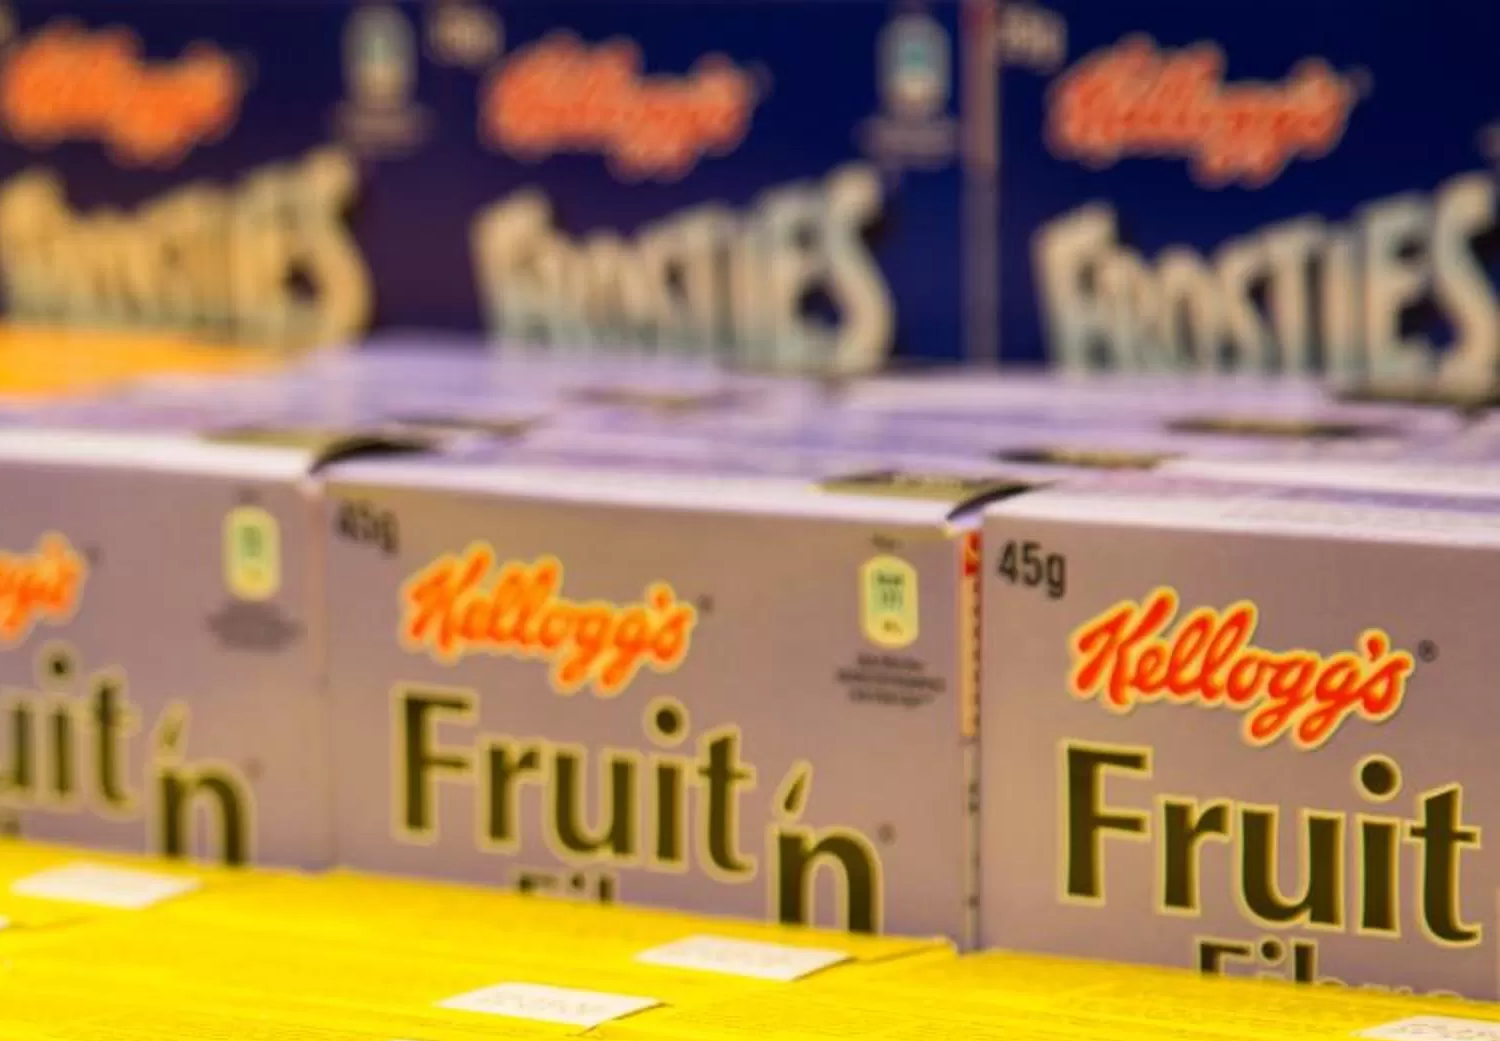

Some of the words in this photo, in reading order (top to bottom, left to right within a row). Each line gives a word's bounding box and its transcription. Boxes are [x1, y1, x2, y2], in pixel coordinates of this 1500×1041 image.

[406, 545, 693, 692] Kellogg's
[997, 541, 1067, 598] 45g
[1073, 589, 1412, 746] Kellogg's
[400, 690, 753, 878] Fruit
[1063, 741, 1480, 943] Fruit
